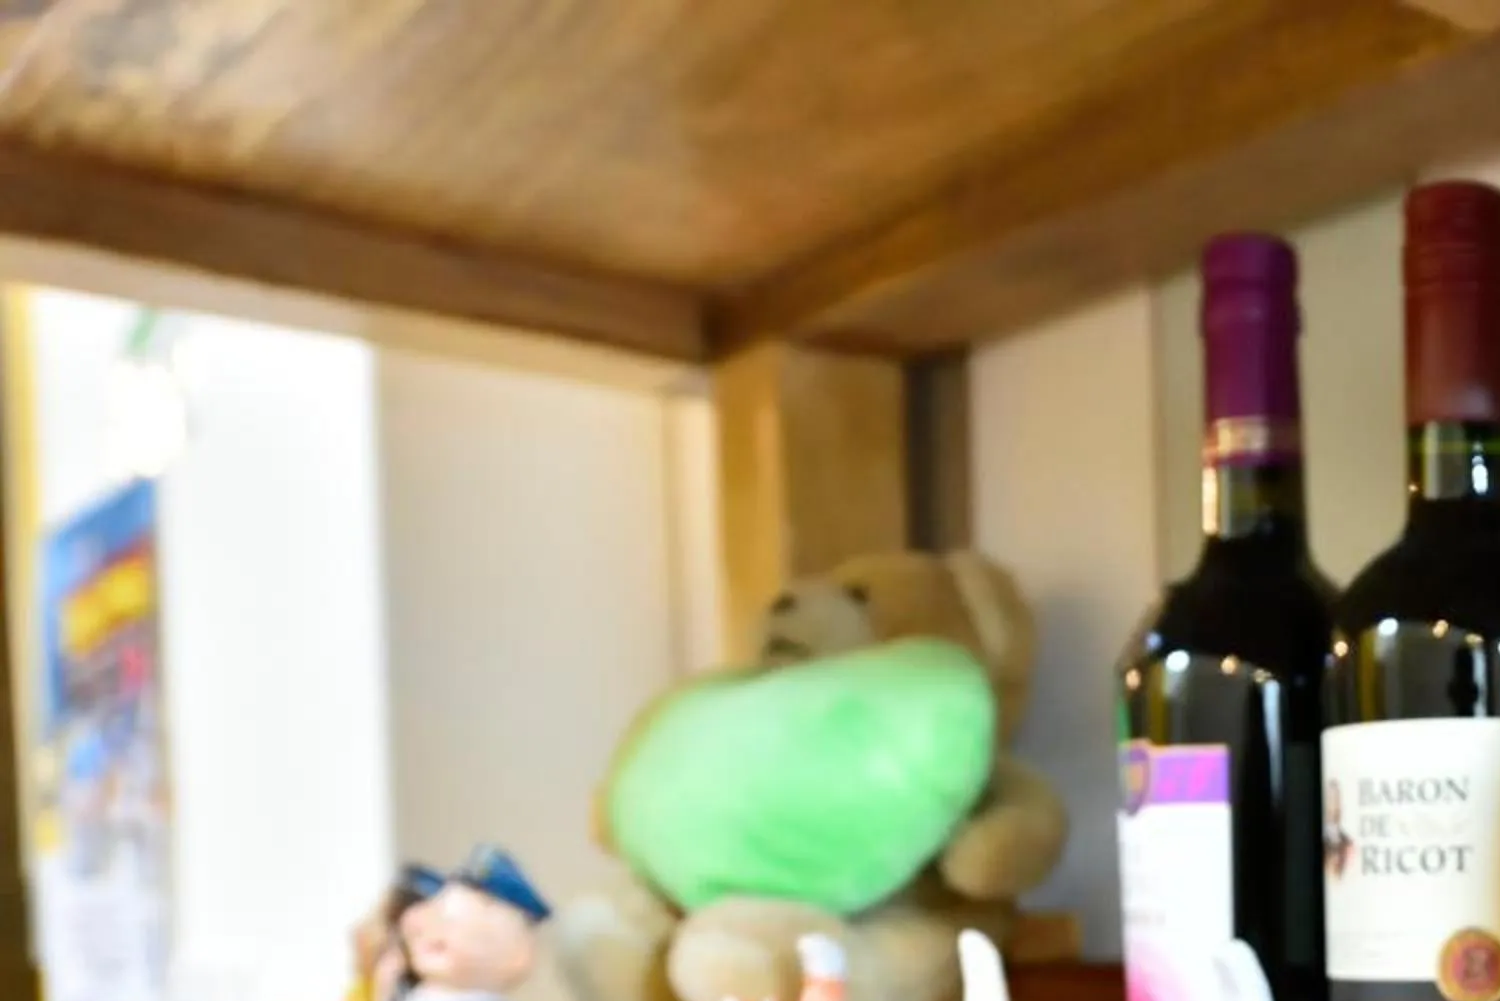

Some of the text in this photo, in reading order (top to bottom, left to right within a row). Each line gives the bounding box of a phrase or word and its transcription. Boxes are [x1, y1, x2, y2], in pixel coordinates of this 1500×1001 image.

[1358, 776, 1470, 807] BARON
[1359, 813, 1392, 838] DE
[1361, 845, 1475, 875] RICOT
